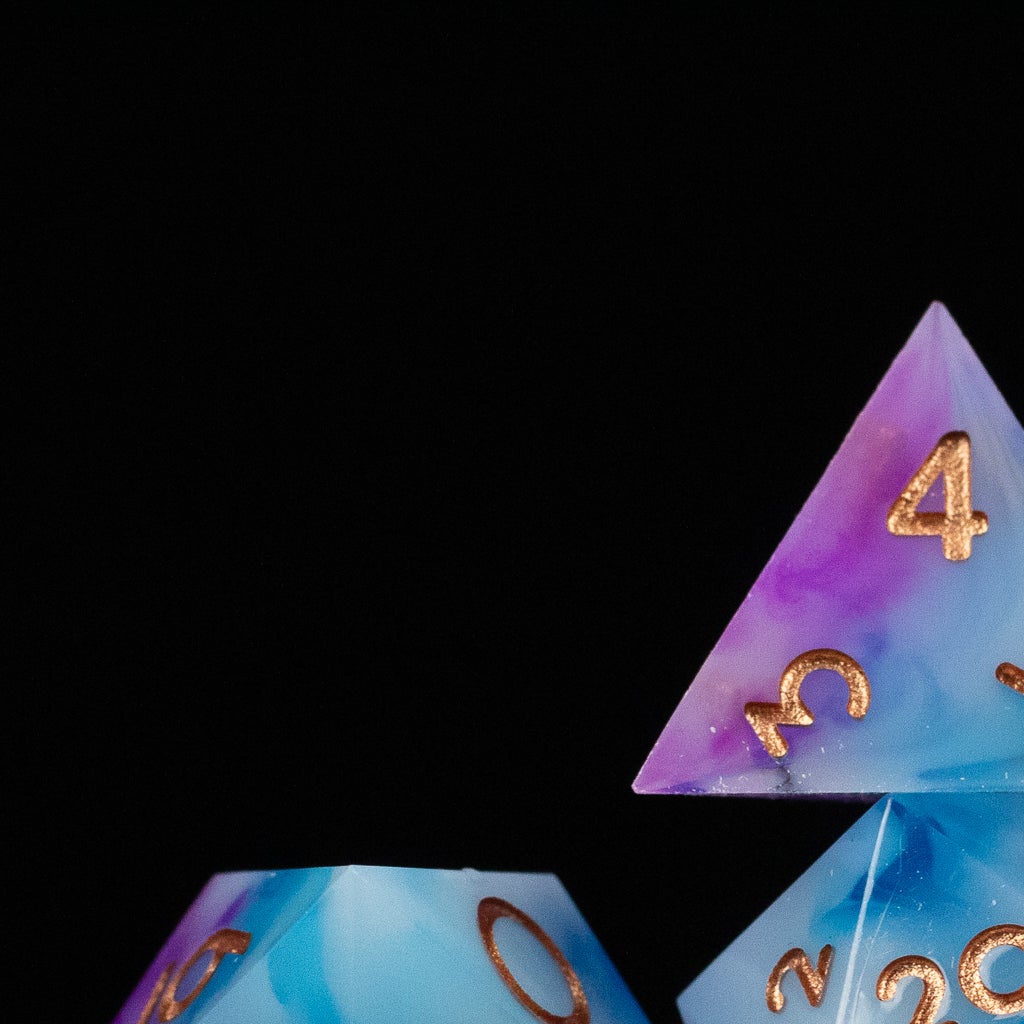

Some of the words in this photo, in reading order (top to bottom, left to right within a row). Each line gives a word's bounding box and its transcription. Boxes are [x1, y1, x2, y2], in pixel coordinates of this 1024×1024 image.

[886, 432, 989, 561] 4
[743, 649, 871, 757] 3
[766, 944, 834, 1013] 2
